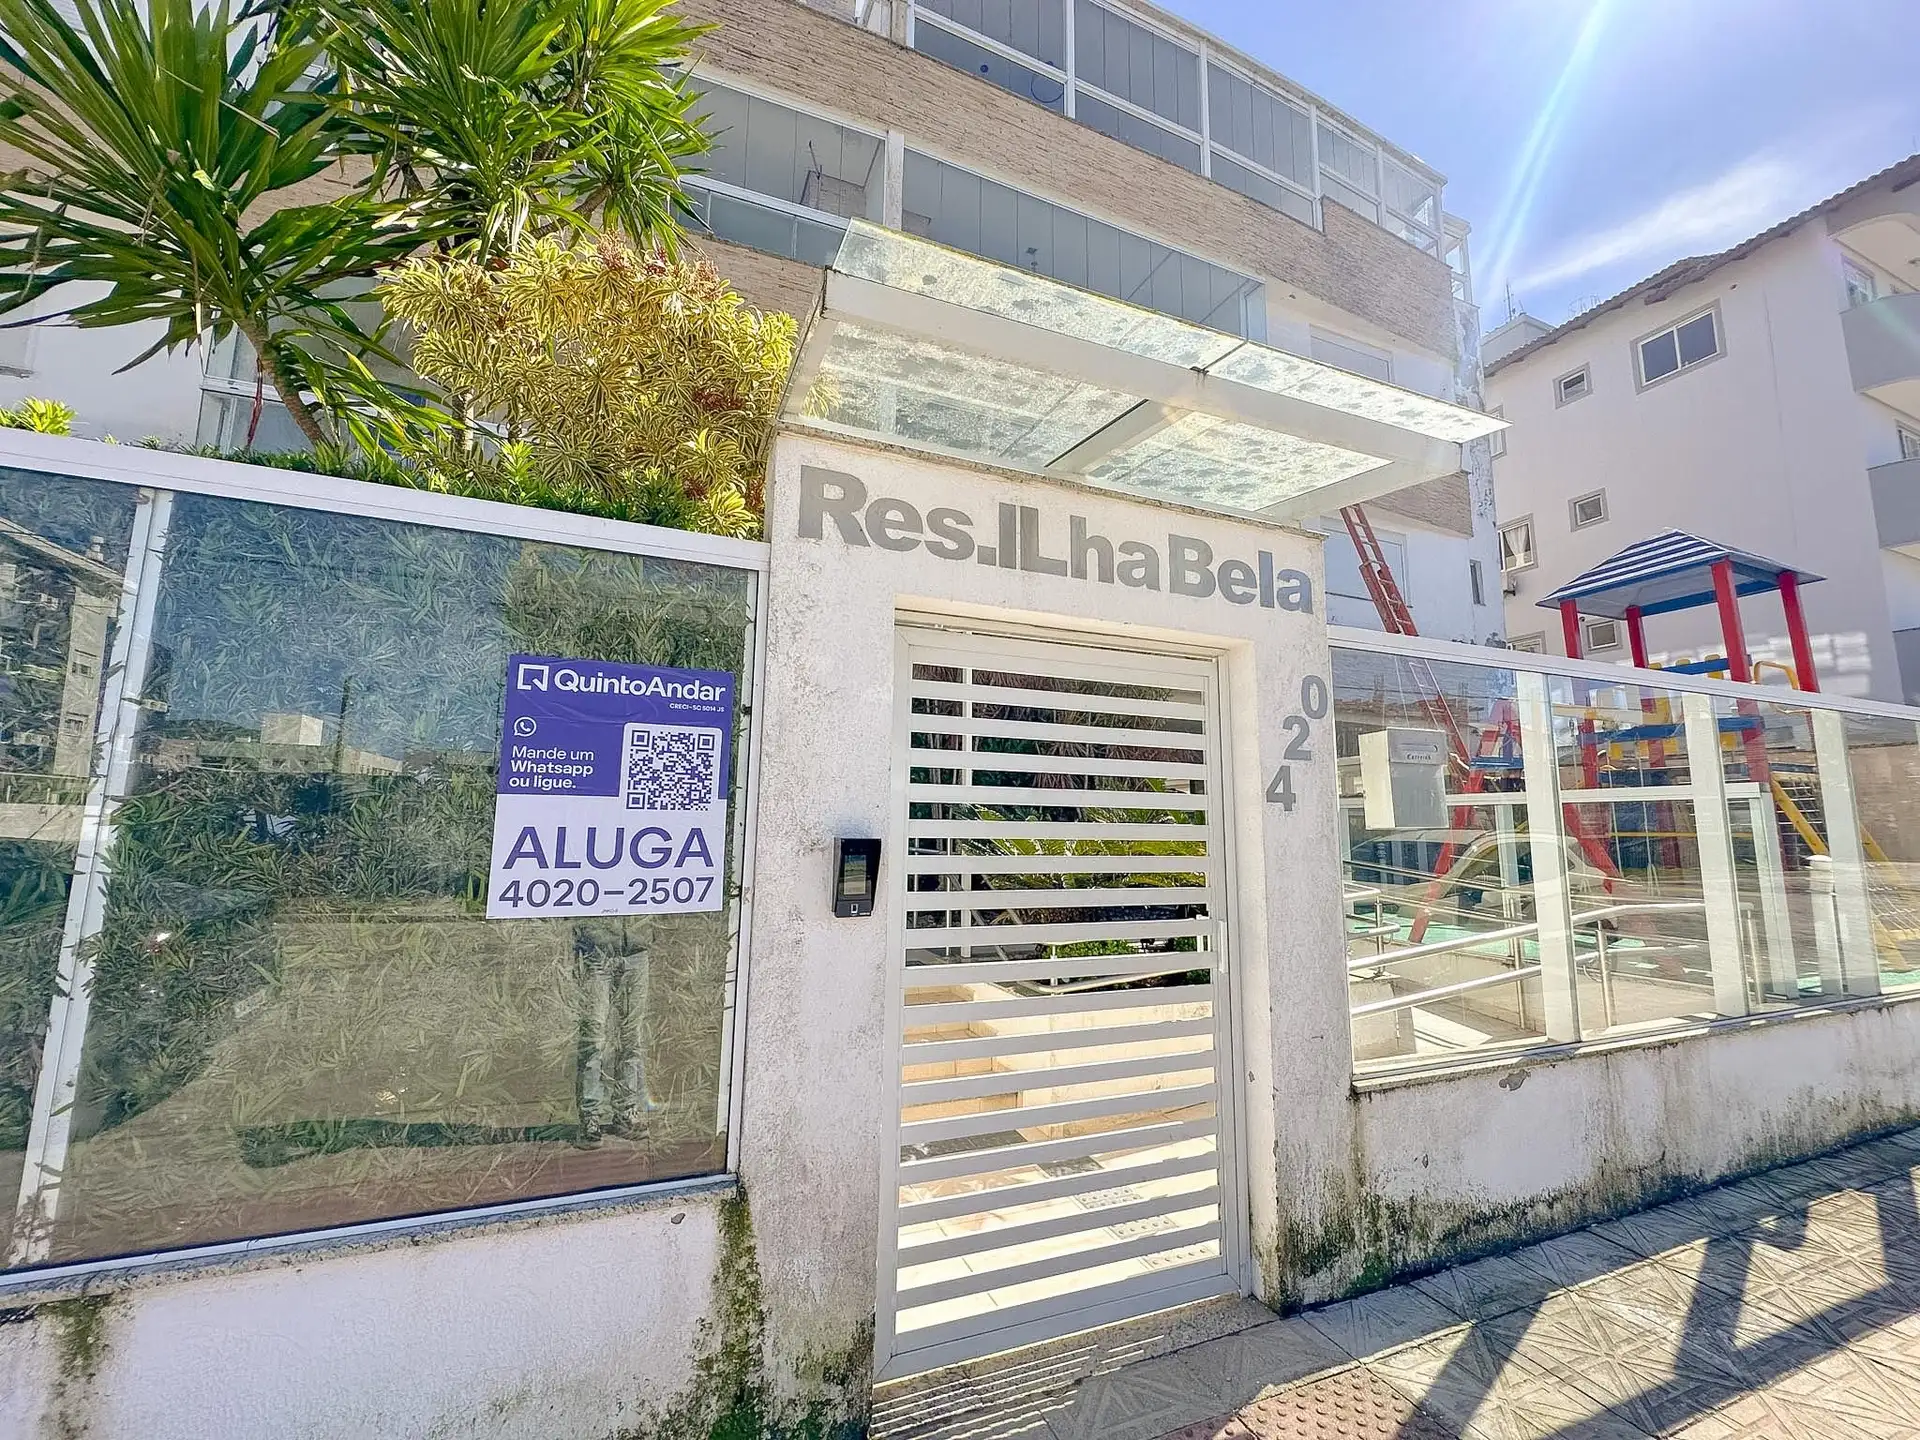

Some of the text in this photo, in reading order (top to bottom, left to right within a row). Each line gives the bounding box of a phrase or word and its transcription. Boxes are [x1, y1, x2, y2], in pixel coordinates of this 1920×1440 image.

[554, 668, 726, 701] QuintoAndar
[512, 745, 594, 761] Mande um
[510, 760, 594, 777] Whatsapp
[508, 775, 577, 791] ou ligue.
[502, 826, 714, 870] ALUGA
[498, 876, 715, 908] 4020-2507
